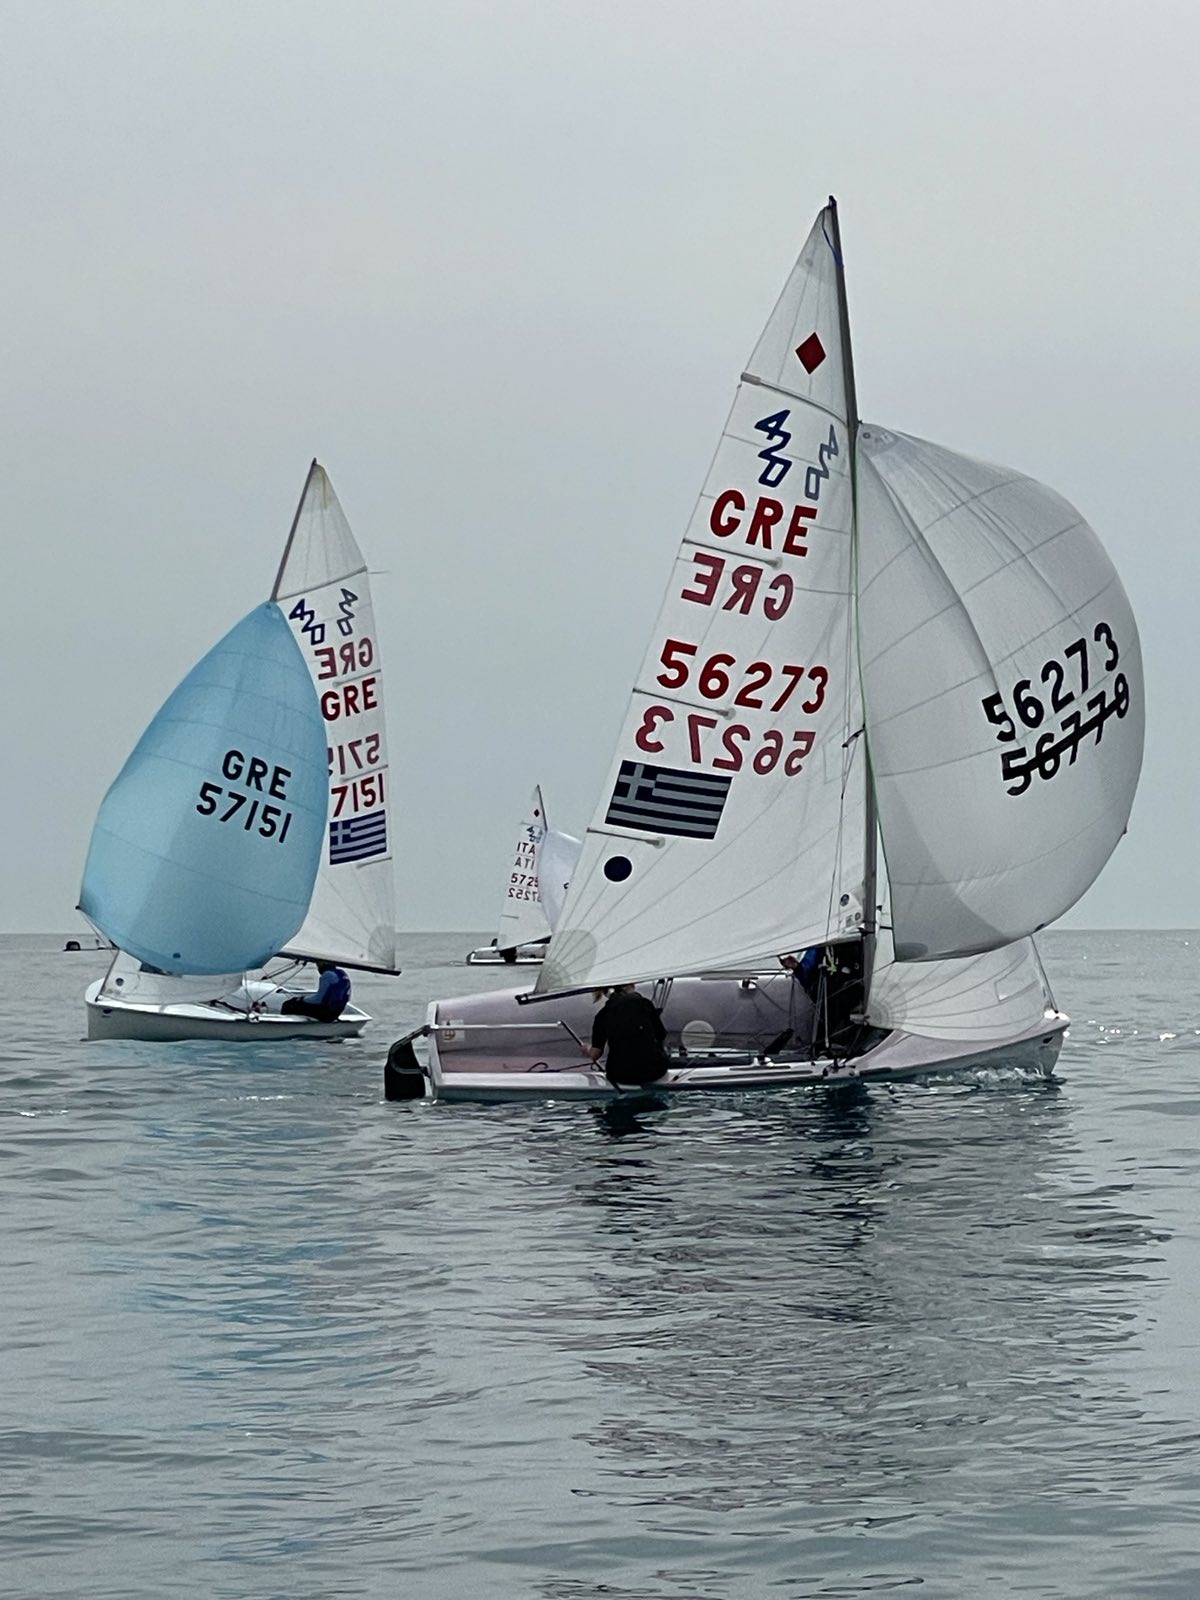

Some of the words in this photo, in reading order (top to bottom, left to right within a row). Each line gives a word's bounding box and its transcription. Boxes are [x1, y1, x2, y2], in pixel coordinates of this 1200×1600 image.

[754, 409, 792, 488] 420
[709, 489, 818, 557] GRE
[288, 598, 326, 646] 420
[321, 677, 378, 721] GRE
[656, 638, 829, 714] 56273
[981, 622, 1119, 742] 56273
[221, 750, 292, 800] GRE
[331, 773, 384, 818] 7151
[196, 781, 293, 844] 57151
[516, 842, 536, 854] ITA
